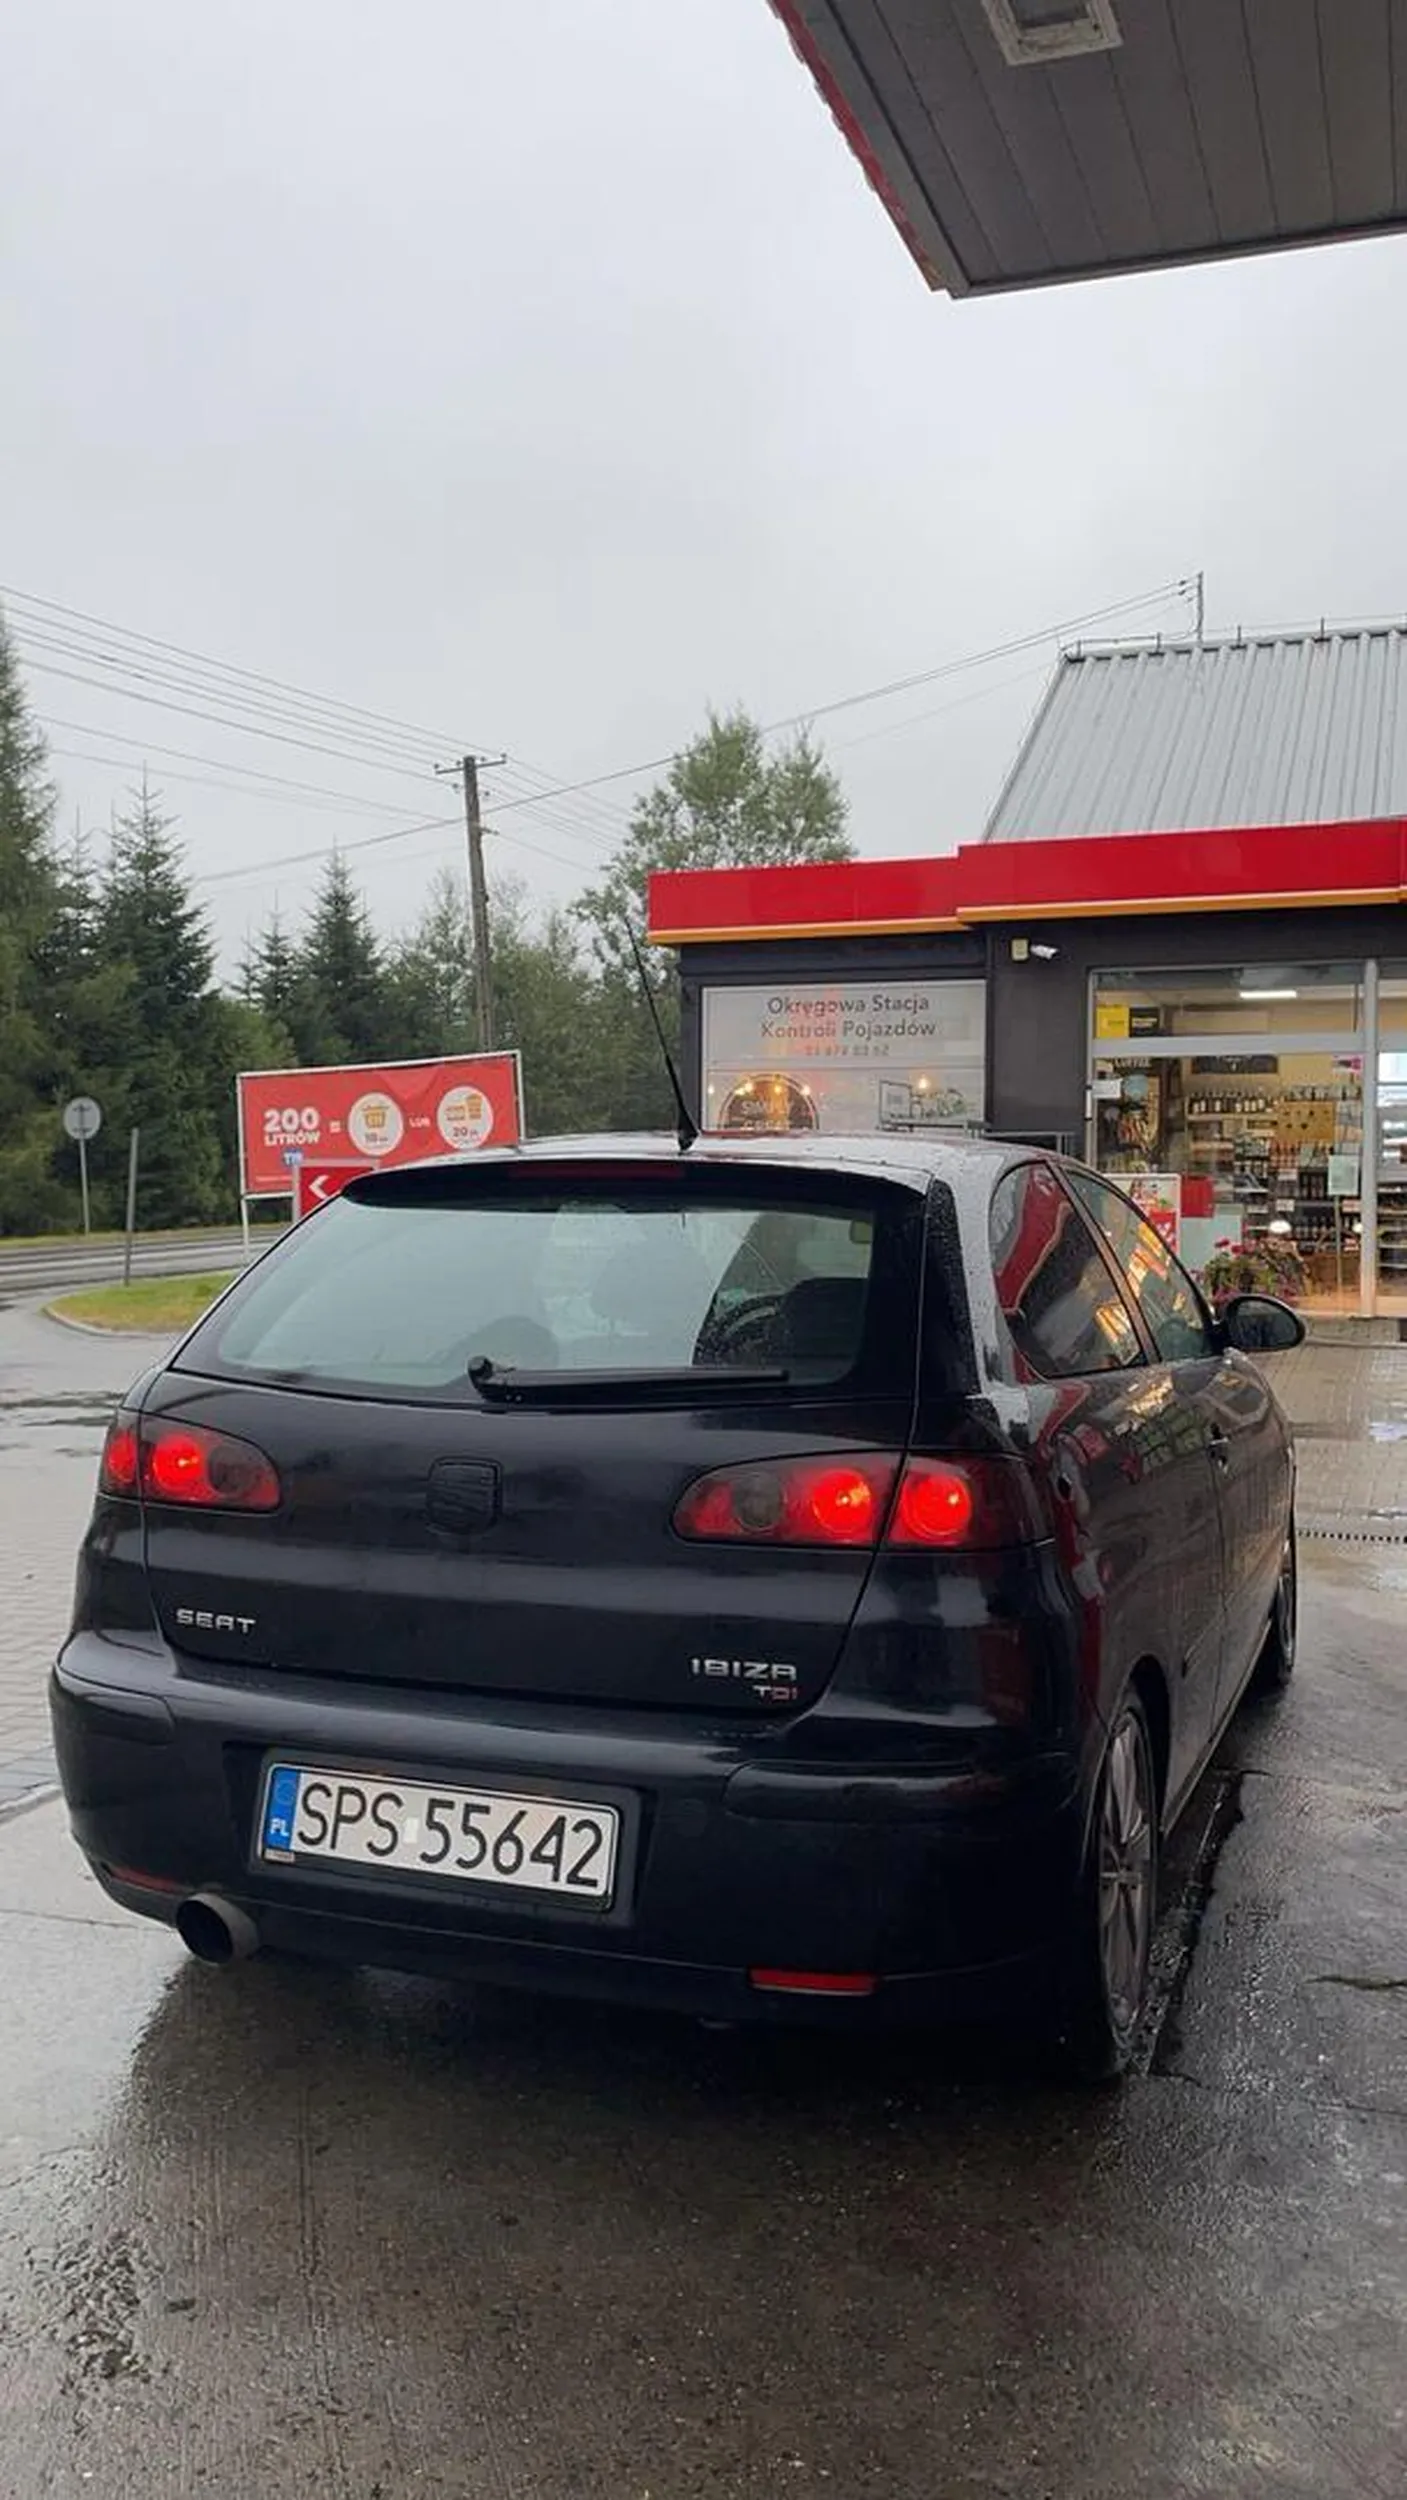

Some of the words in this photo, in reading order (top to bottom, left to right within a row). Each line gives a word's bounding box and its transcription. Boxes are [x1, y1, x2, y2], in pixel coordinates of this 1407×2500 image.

[767, 996, 866, 1017] Okręgowa
[871, 993, 931, 1014] Stacja
[761, 1019, 837, 1038] Kontroli
[842, 1018, 936, 1041] Pojazdów
[263, 1106, 320, 1132] 200
[264, 1129, 321, 1147] LITRÓW
[176, 1608, 256, 1634] SEAT
[691, 1657, 797, 1681] IBIZA
[752, 1684, 798, 1701] TDI
[269, 1817, 290, 1837] PL
[297, 1782, 404, 1857] SPS
[419, 1797, 604, 1888] 55642
